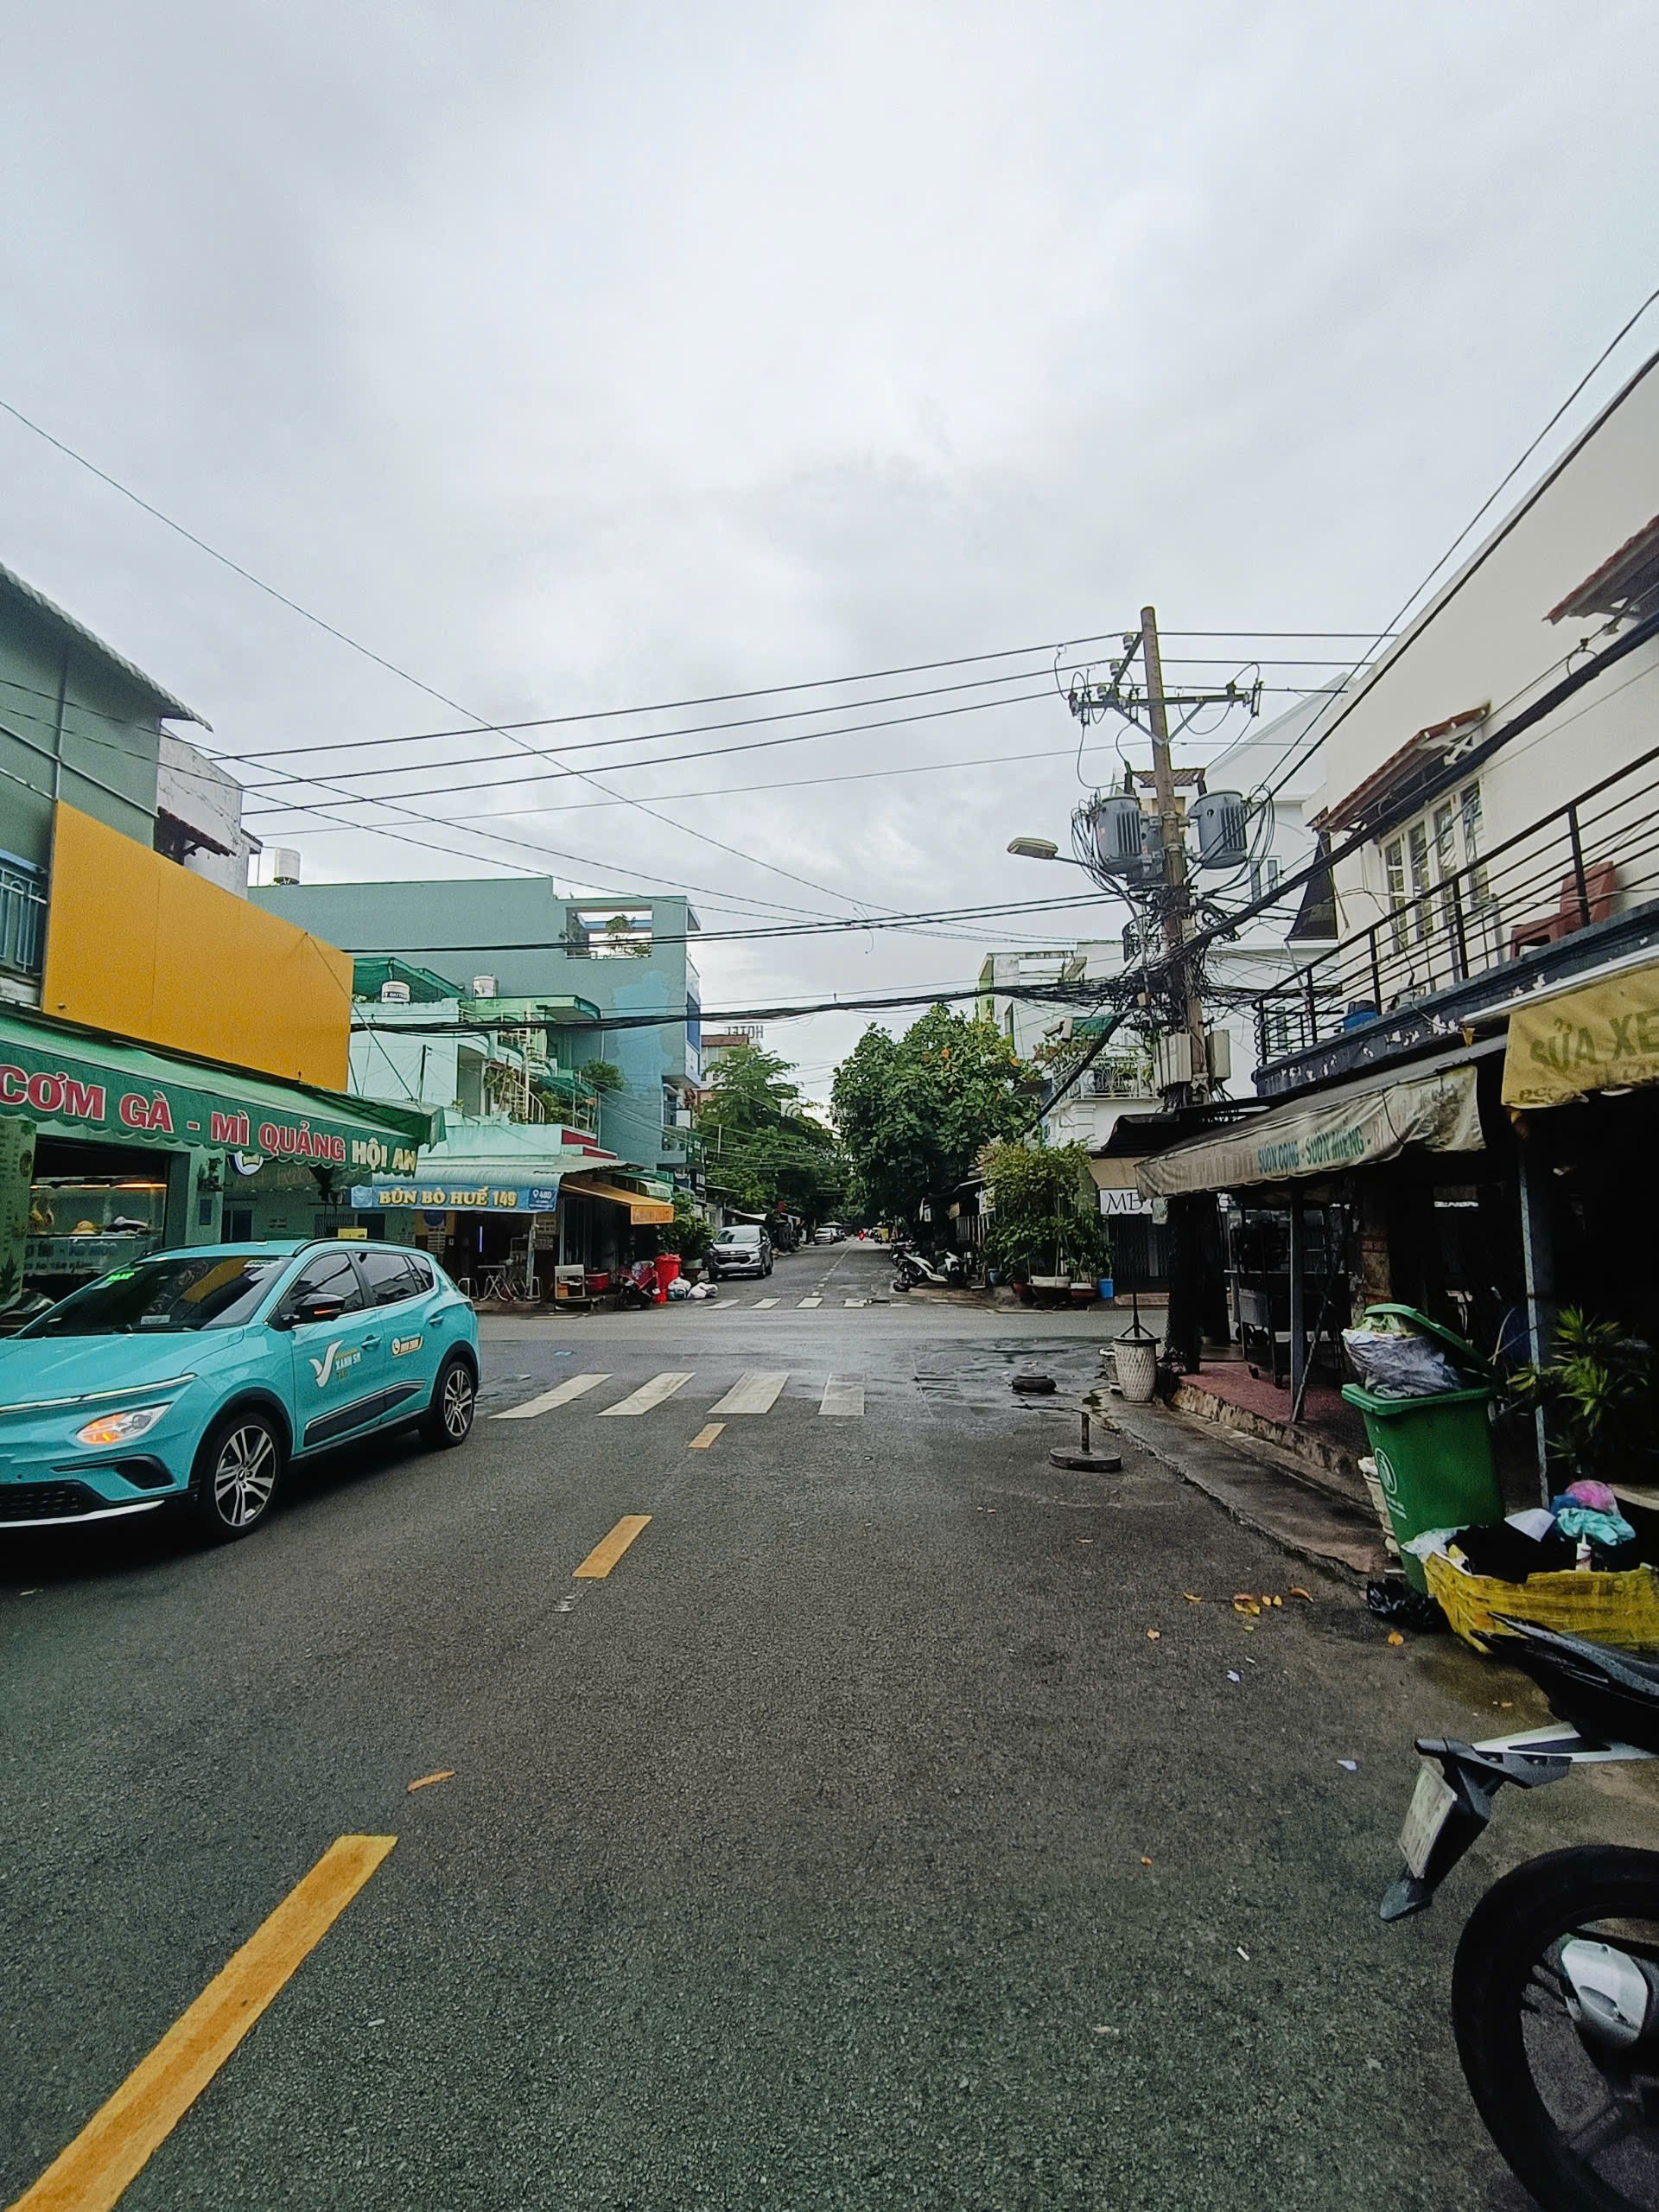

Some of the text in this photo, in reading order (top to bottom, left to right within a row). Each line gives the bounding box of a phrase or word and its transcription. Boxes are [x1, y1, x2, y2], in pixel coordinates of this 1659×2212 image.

[1530, 1007, 1659, 1073] SỬA XE
[0, 1064, 106, 1122] CƠM
[119, 1090, 175, 1134] GÀ
[210, 1109, 250, 1147] MÌ
[258, 1121, 346, 1161] QUẢNG
[352, 1137, 387, 1171] HỘI
[391, 1147, 417, 1172] AN
[378, 1185, 518, 1207] BÚN BÒ HUẾ 149
